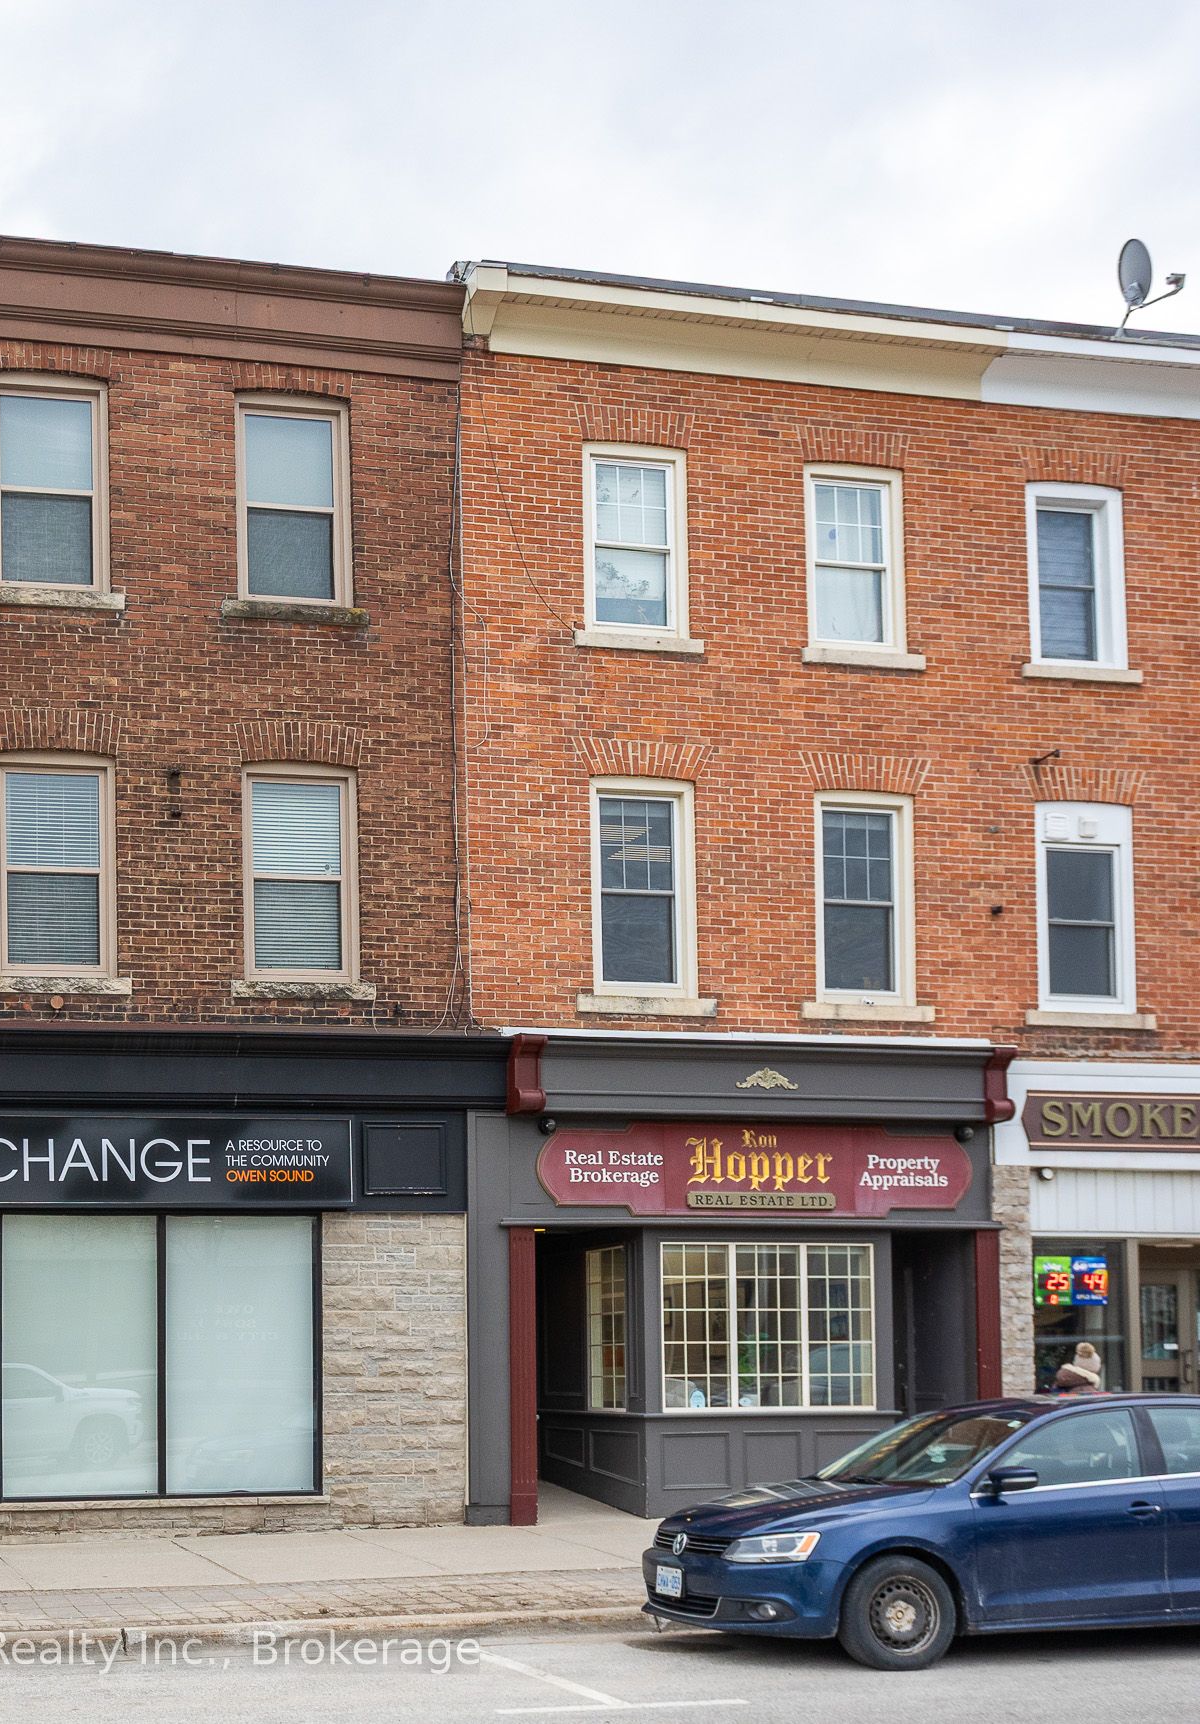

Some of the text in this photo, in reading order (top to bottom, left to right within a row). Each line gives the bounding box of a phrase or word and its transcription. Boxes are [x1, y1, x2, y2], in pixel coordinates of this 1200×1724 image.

[225, 1140, 322, 1151] A RESOURCE TO
[742, 1129, 777, 1148] Ron
[225, 1155, 330, 1167] THE COMMUNITY
[564, 1150, 664, 1166] Real Estate
[685, 1136, 833, 1192] Hopper
[867, 1154, 940, 1174] Property
[226, 1170, 315, 1182] OWEN SOUND
[569, 1168, 659, 1187] Brokerage
[859, 1171, 949, 1190] Appraisals
[695, 1195, 833, 1207] REAL ESTATE LTD.
[1046, 1272, 1070, 1290] 25
[1083, 1273, 1105, 1290] 44
